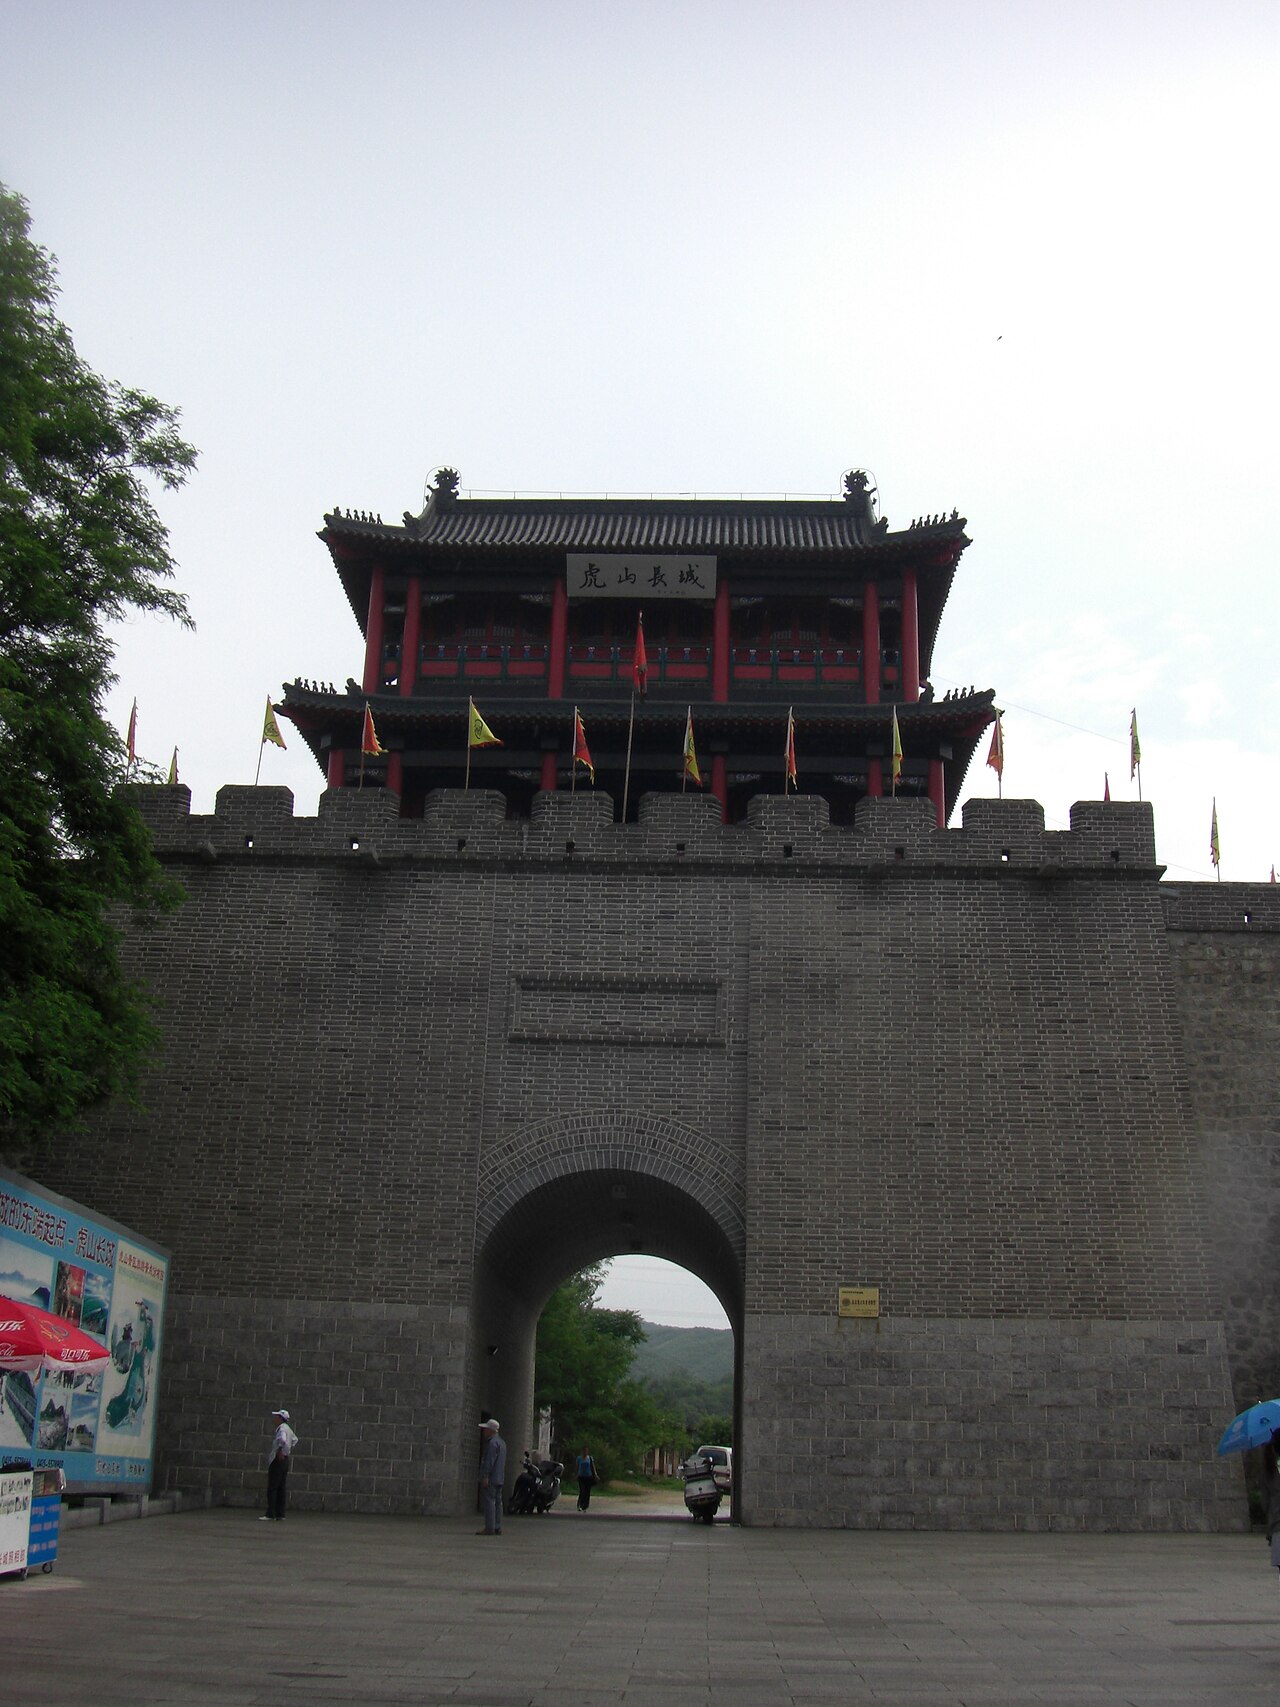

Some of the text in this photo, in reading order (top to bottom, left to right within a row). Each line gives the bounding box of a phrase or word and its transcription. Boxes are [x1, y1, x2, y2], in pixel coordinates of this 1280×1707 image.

[579, 562, 705, 589] 虎山長城
[61, 1348, 91, 1361] 可口可乐
